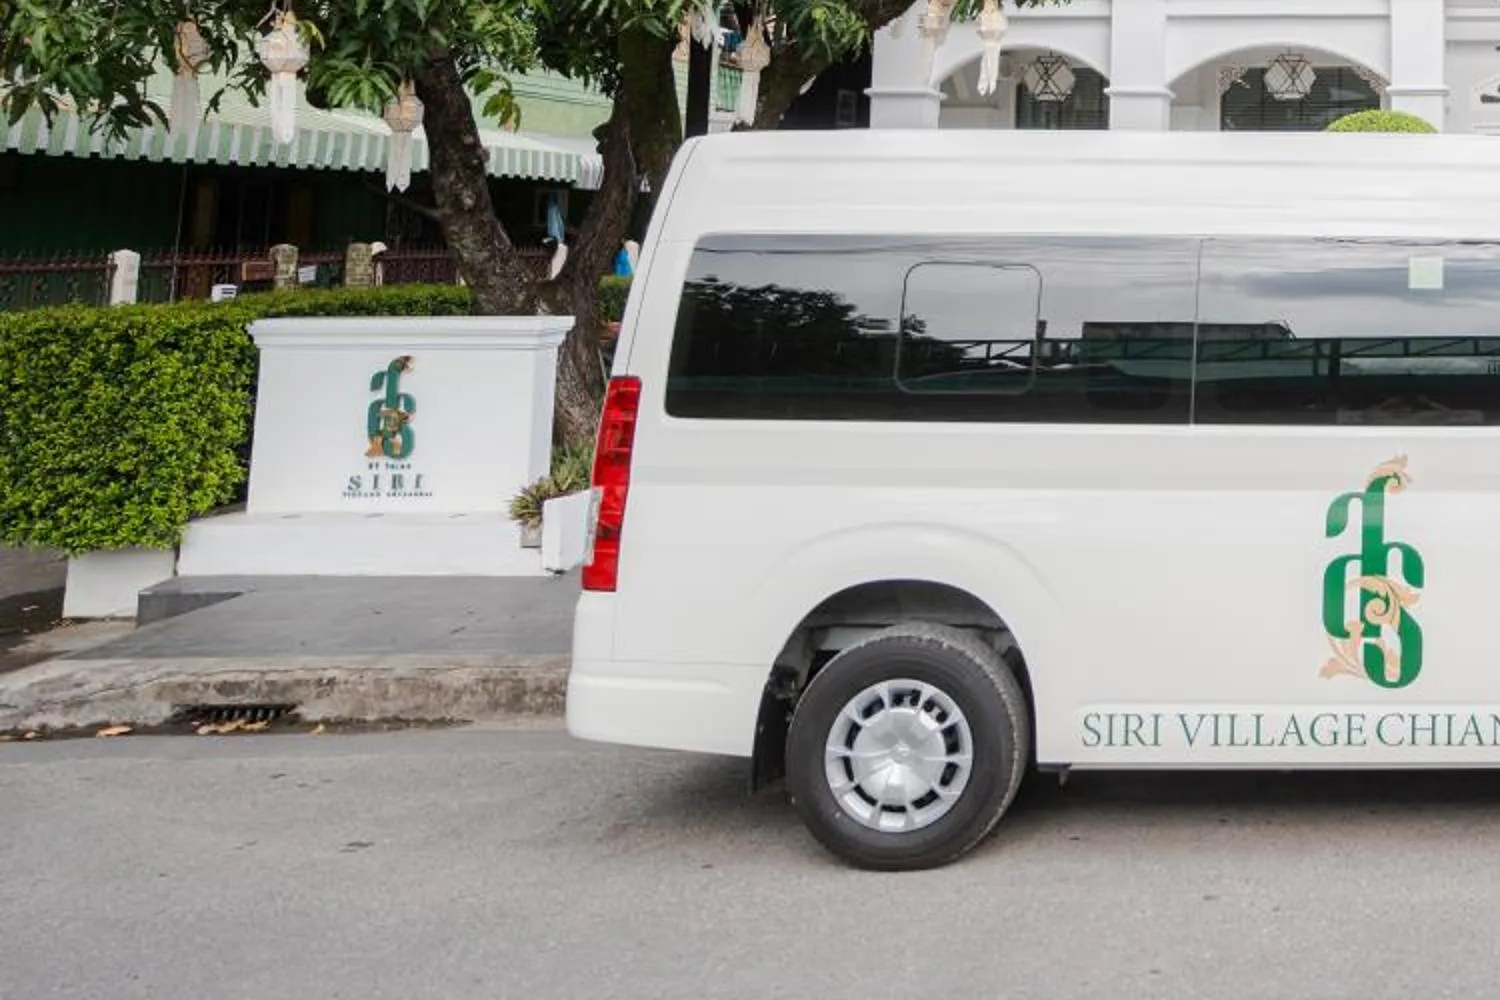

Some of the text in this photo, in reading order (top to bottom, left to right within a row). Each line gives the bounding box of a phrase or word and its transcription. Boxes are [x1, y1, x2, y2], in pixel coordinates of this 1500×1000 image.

[347, 473, 423, 490] SIRI
[1081, 713, 1162, 747] SIRI
[1176, 713, 1368, 748] VILLAGE
